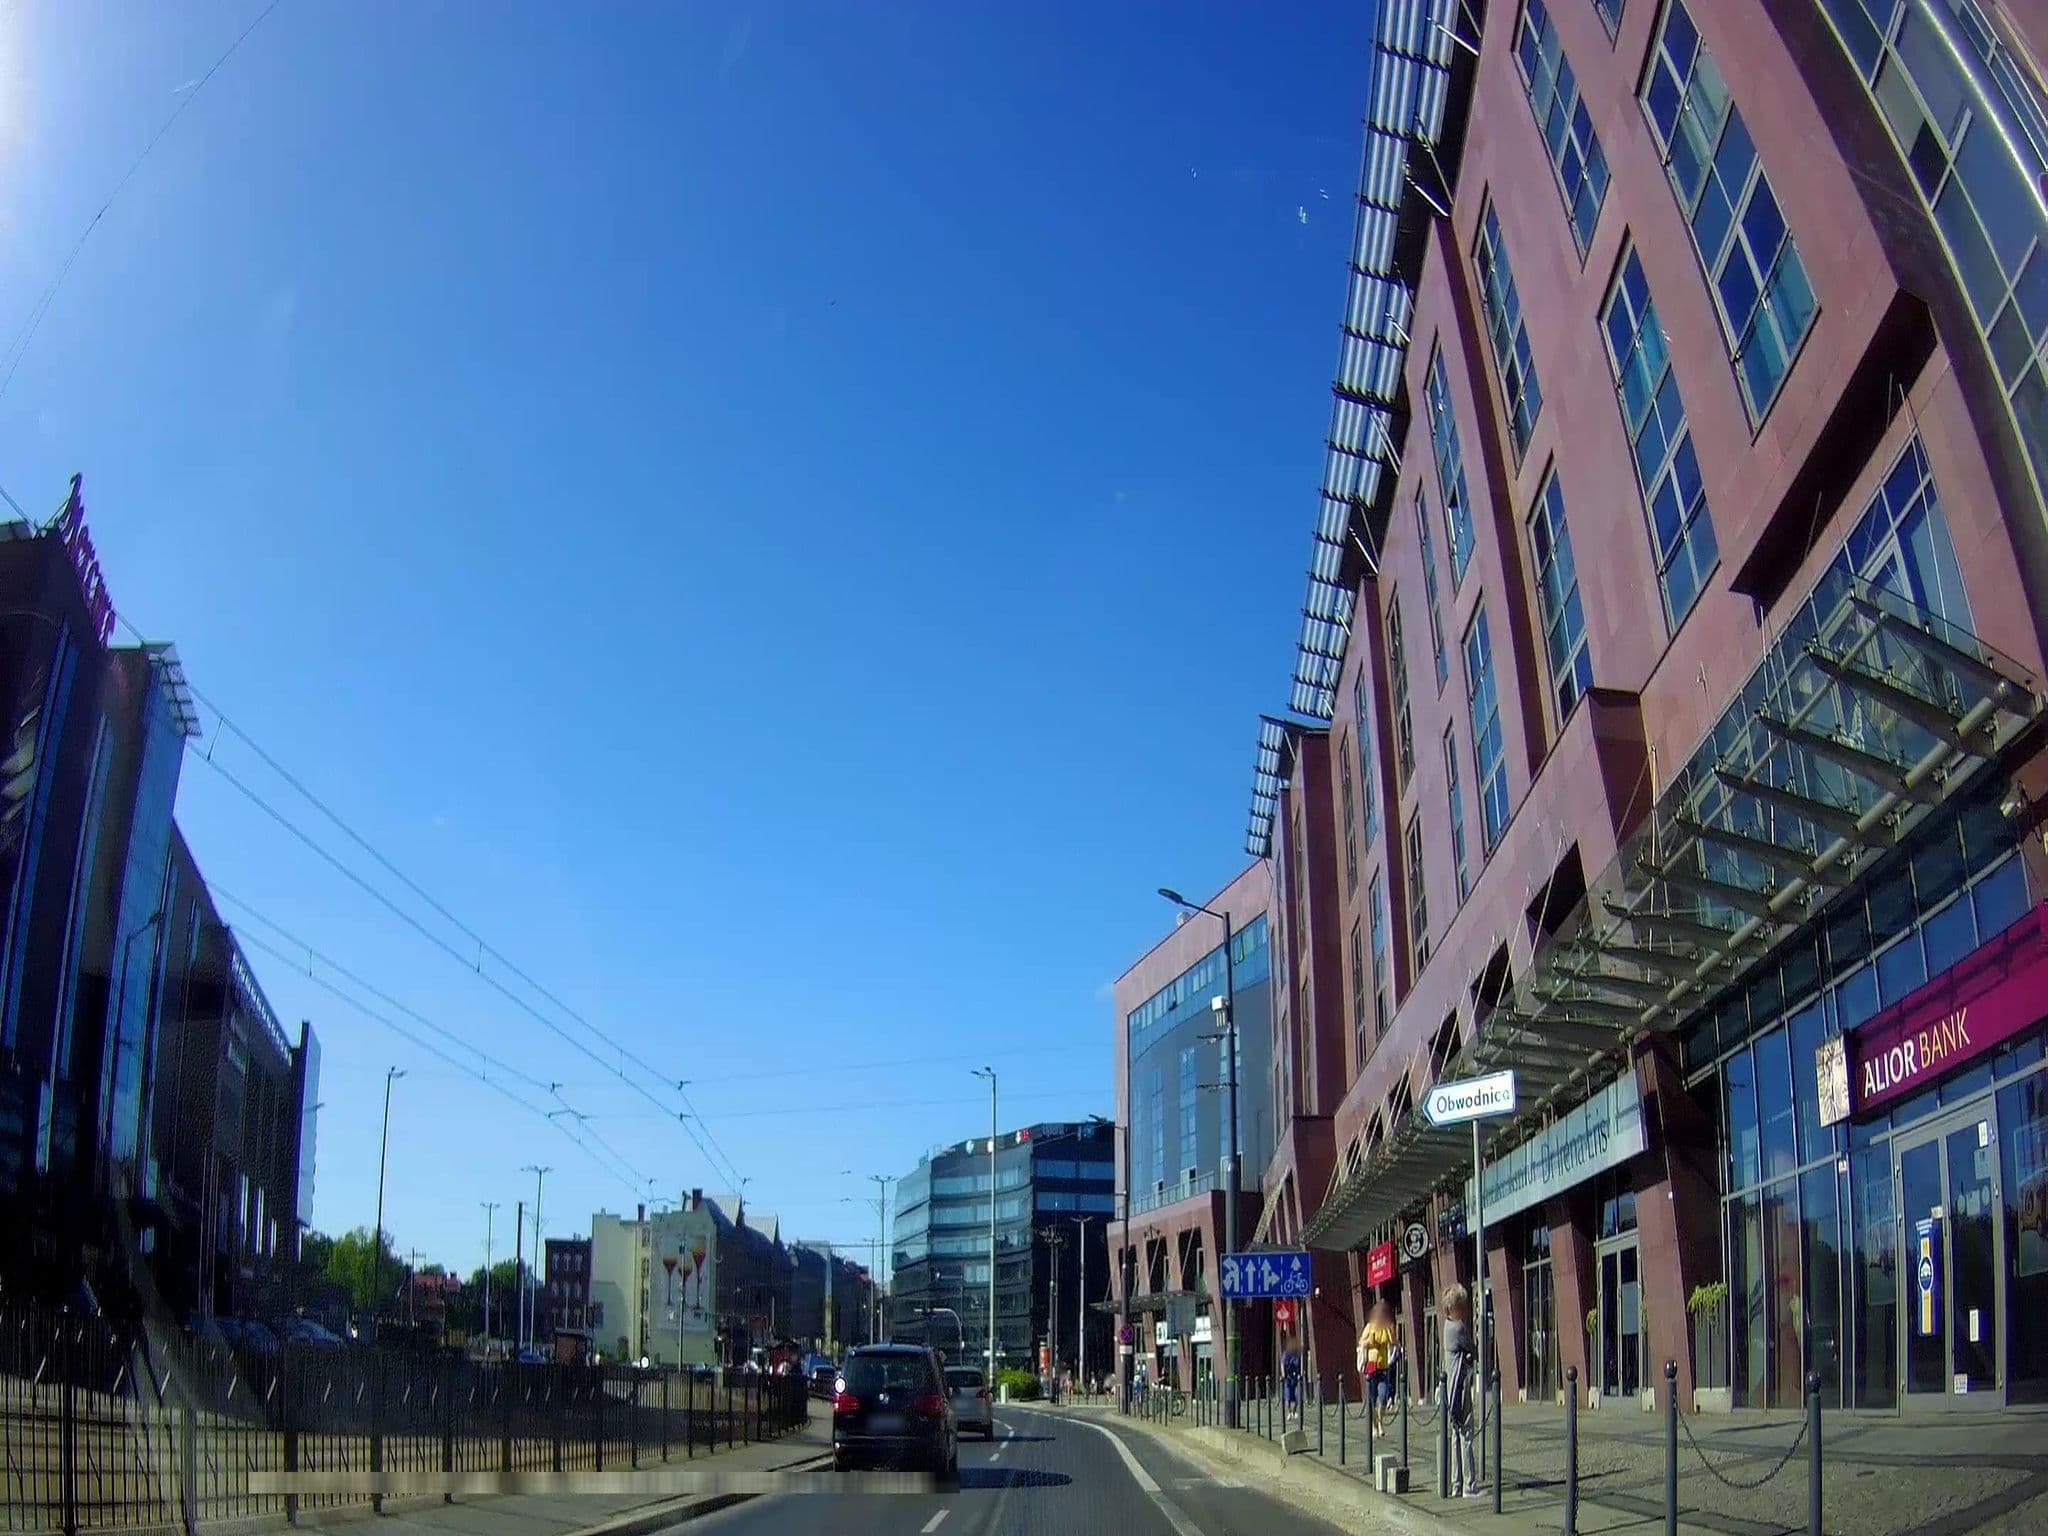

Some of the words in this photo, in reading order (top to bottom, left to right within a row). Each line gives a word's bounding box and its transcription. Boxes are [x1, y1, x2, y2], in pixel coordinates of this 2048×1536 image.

[1864, 1039, 1918, 1099] ALIOR
[1919, 1006, 1971, 1069] BANK
[1436, 1086, 1510, 1114] Obwodnica
[1555, 1134, 1585, 1177] Irena
[1585, 1110, 1608, 1160] Eris
